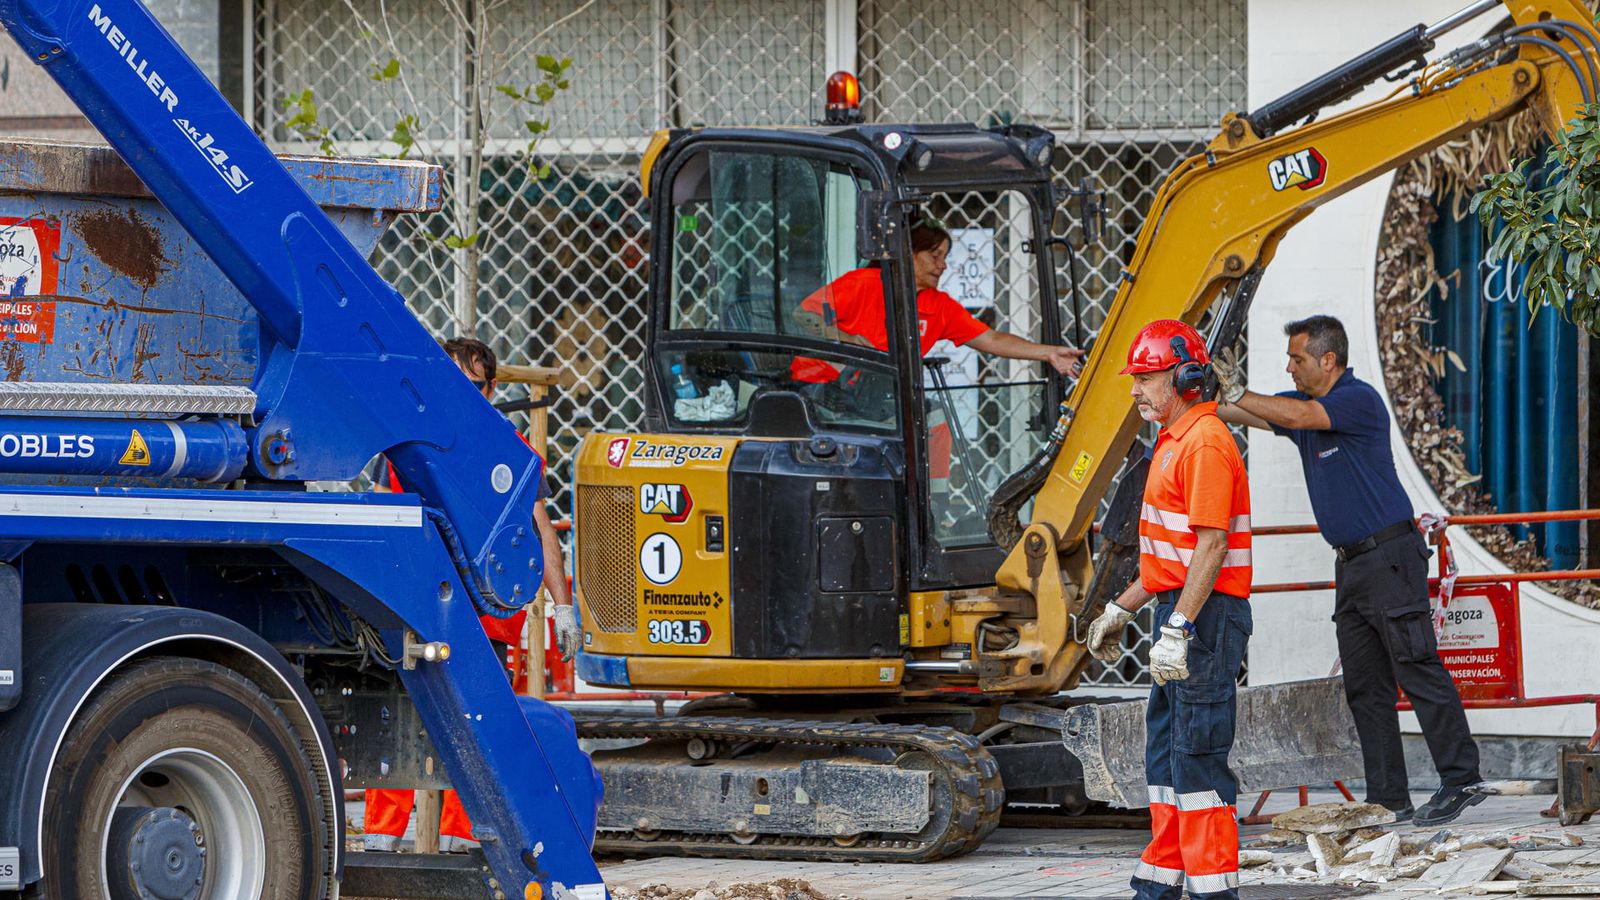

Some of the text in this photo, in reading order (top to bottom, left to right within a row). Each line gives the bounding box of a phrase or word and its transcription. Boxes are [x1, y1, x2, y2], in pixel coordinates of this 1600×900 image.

[88, 4, 179, 113] MEILLER
[1269, 149, 1312, 190] CAT
[1478, 247, 1521, 302] El
[632, 441, 723, 465] Zaragoza
[641, 483, 681, 514] CAT
[653, 542, 665, 574] 1
[643, 589, 712, 607] Finanzauto
[648, 620, 702, 643] 303.5
